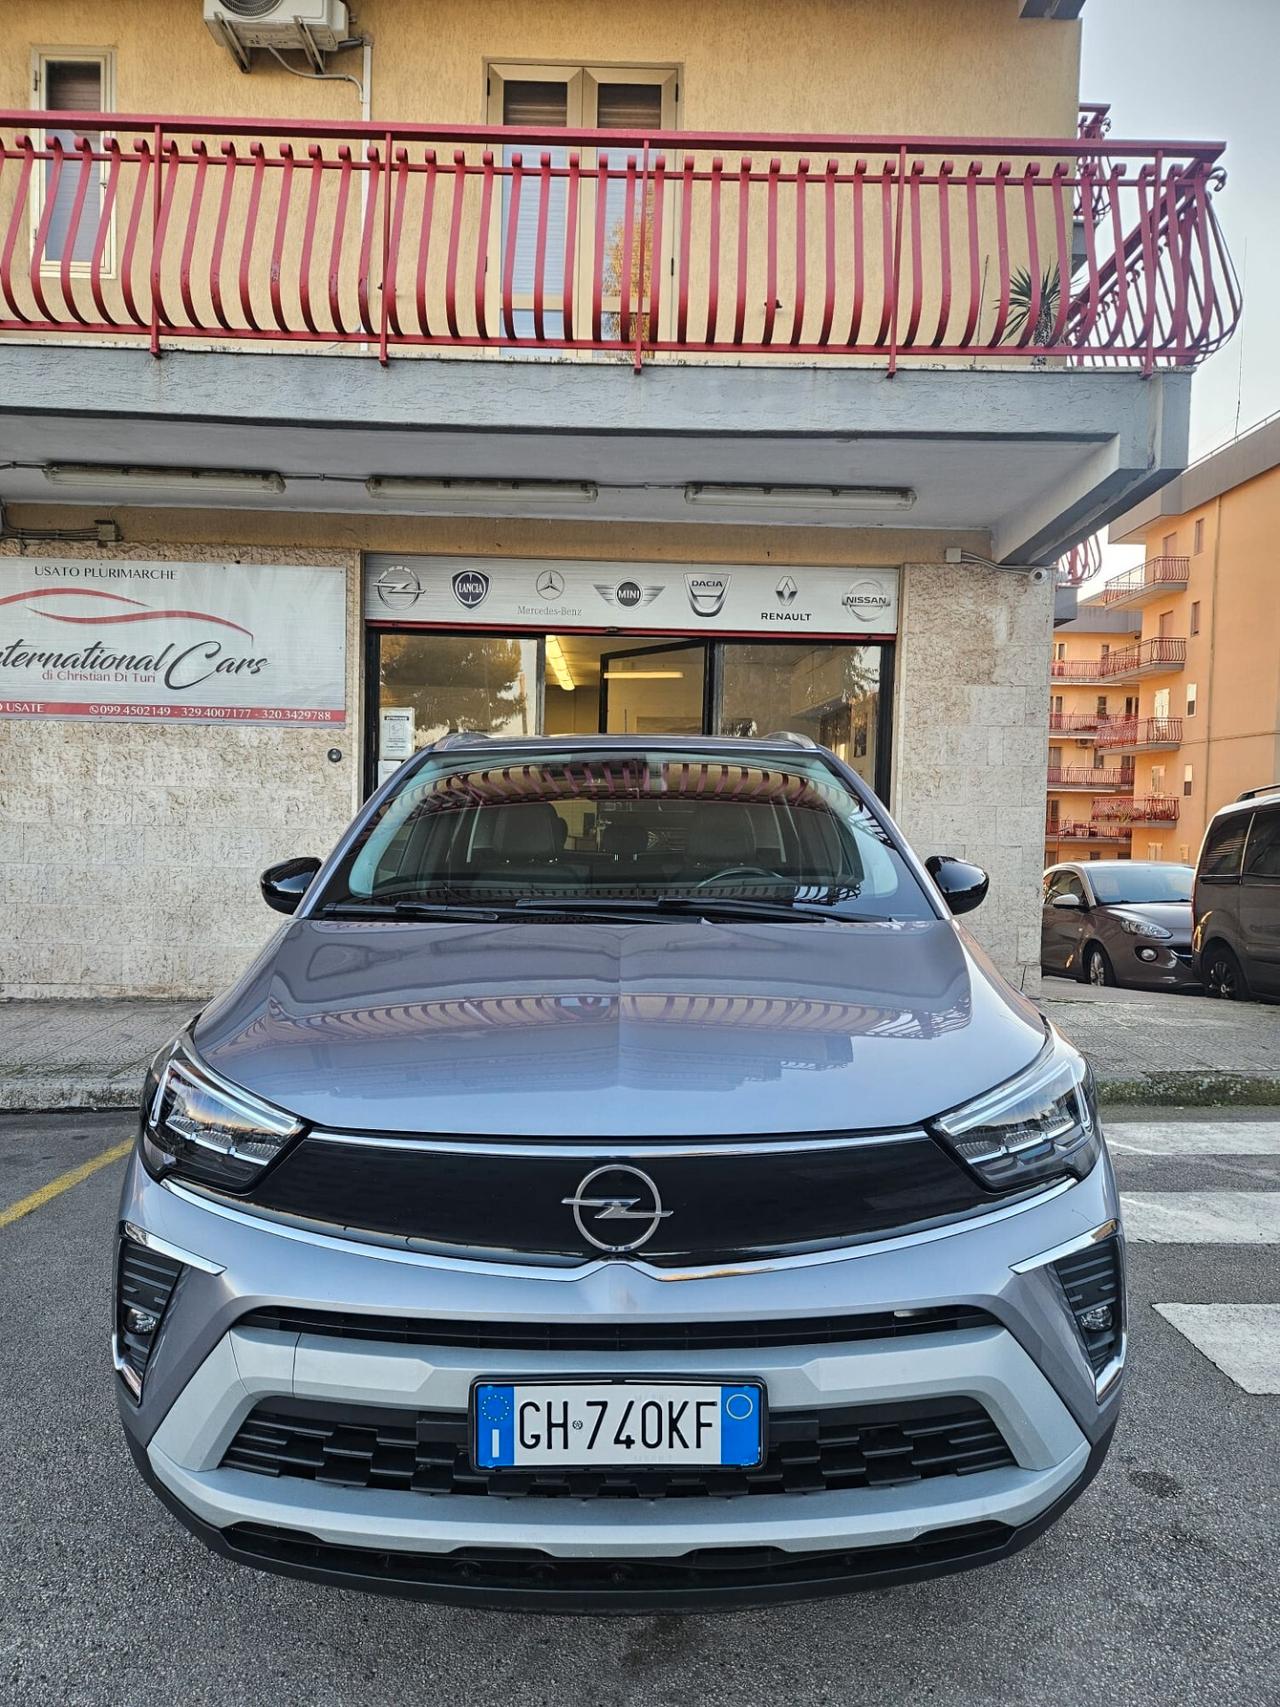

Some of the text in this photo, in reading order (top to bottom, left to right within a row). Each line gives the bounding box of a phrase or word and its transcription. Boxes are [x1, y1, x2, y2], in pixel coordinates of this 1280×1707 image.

[34, 566, 177, 580] USATO PLURIMARCHE
[458, 582, 483, 594] LANCIA
[691, 579, 723, 588] DACIA
[617, 590, 640, 600] MINI
[846, 596, 887, 605] NISSAN
[517, 605, 582, 616] Mercedes-Benz
[760, 612, 812, 621] RENAULT
[0, 639, 270, 690] ternational Cars
[42, 670, 156, 683] di Christian Di Turi
[6, 703, 45, 713] USATE
[100, 705, 171, 716] 099.4502149
[181, 707, 251, 718] 329.4007177
[262, 710, 331, 721] 320.3429788
